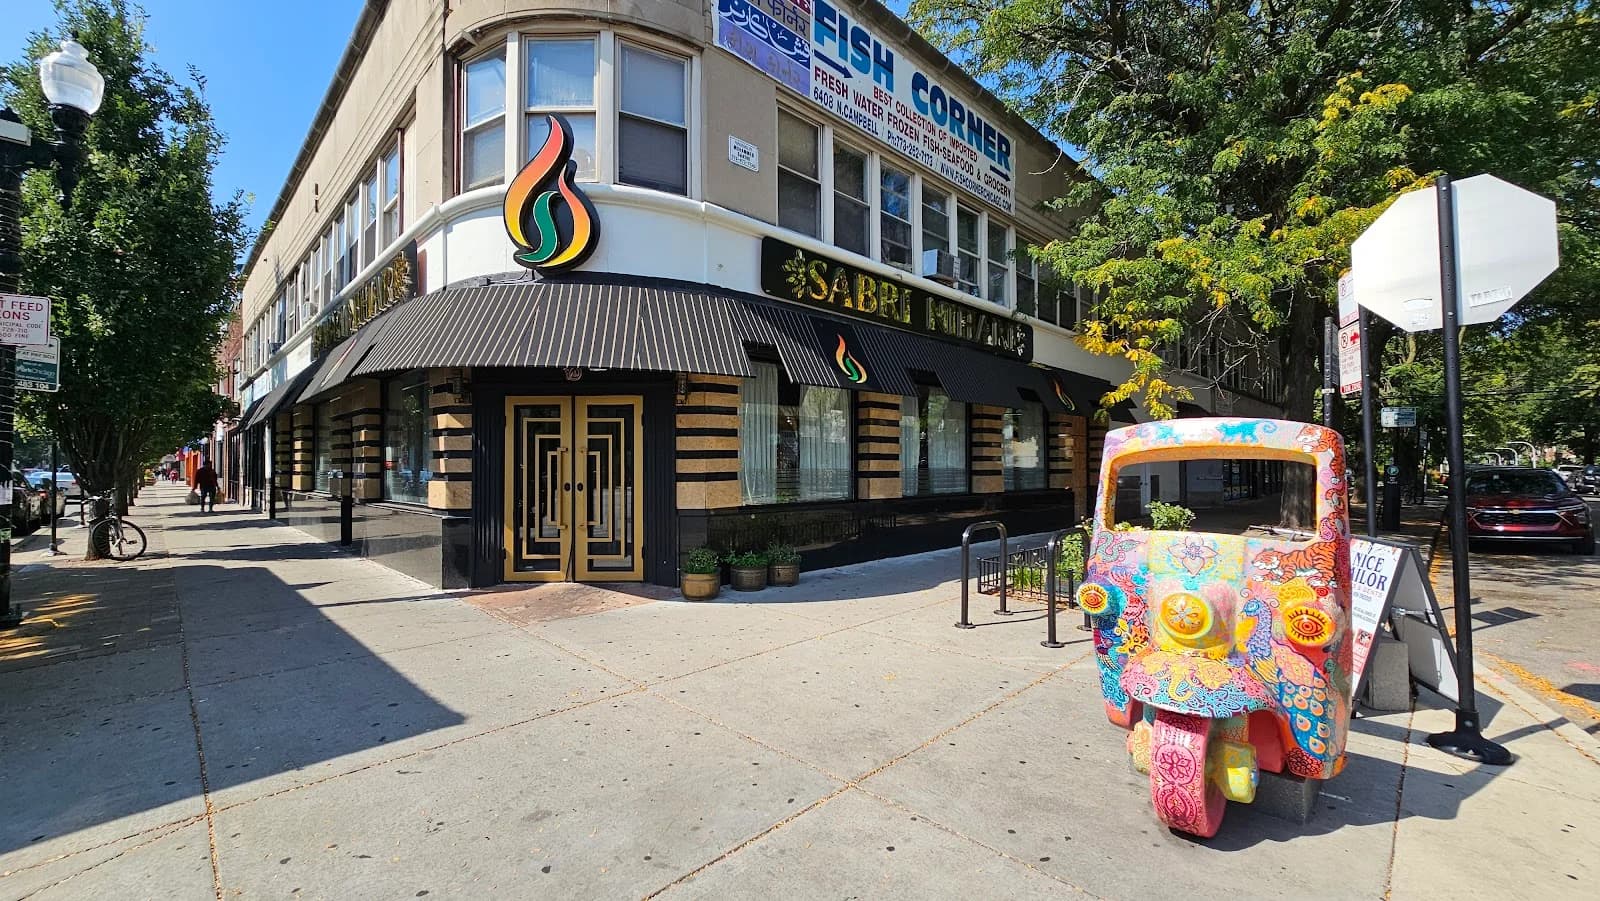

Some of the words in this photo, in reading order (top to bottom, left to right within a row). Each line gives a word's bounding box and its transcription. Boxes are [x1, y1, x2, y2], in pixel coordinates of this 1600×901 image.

[813, 87, 834, 109] 6408
[814, 1, 894, 93] FISH
[911, 71, 1011, 171] CORNER
[814, 66, 848, 100] FRESH
[853, 89, 884, 121] WATER
[887, 112, 919, 144] FROZEN
[923, 135, 974, 176] FISH-SEAFOOD
[976, 168, 981, 181] &
[983, 173, 1012, 198] GROCERY
[873, 86, 893, 108] BEST
[895, 101, 936, 136] COLLECTION
[938, 126, 948, 142] OF
[950, 136, 978, 162] IMPORTED
[11, 301, 44, 312] FEED
[807, 258, 912, 324] SABRI
[0, 310, 31, 321] ONS
[1353, 552, 1384, 573] NICE
